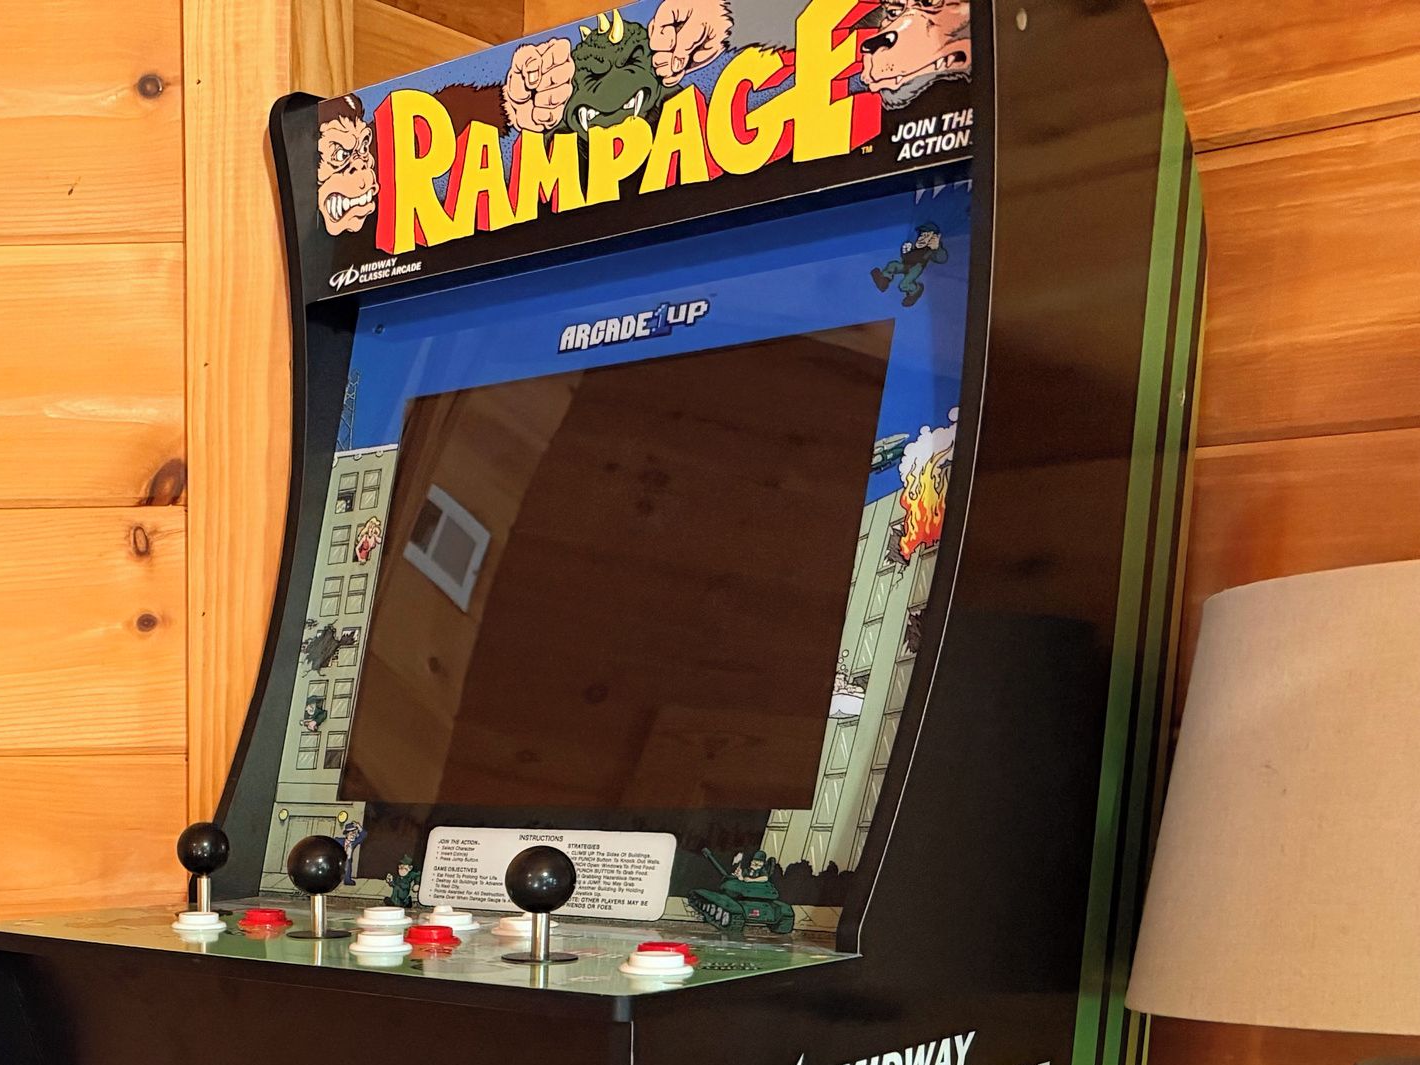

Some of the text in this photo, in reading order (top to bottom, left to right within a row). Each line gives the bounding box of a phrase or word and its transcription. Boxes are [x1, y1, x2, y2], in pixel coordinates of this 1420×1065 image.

[374, 0, 882, 256] RAMPAGE
[891, 107, 973, 143] JOIN THE
[359, 261, 422, 284] CLASSIC ARCADE
[360, 257, 398, 274] MIDWAY
[519, 834, 564, 842] INSTRUCTIONS
